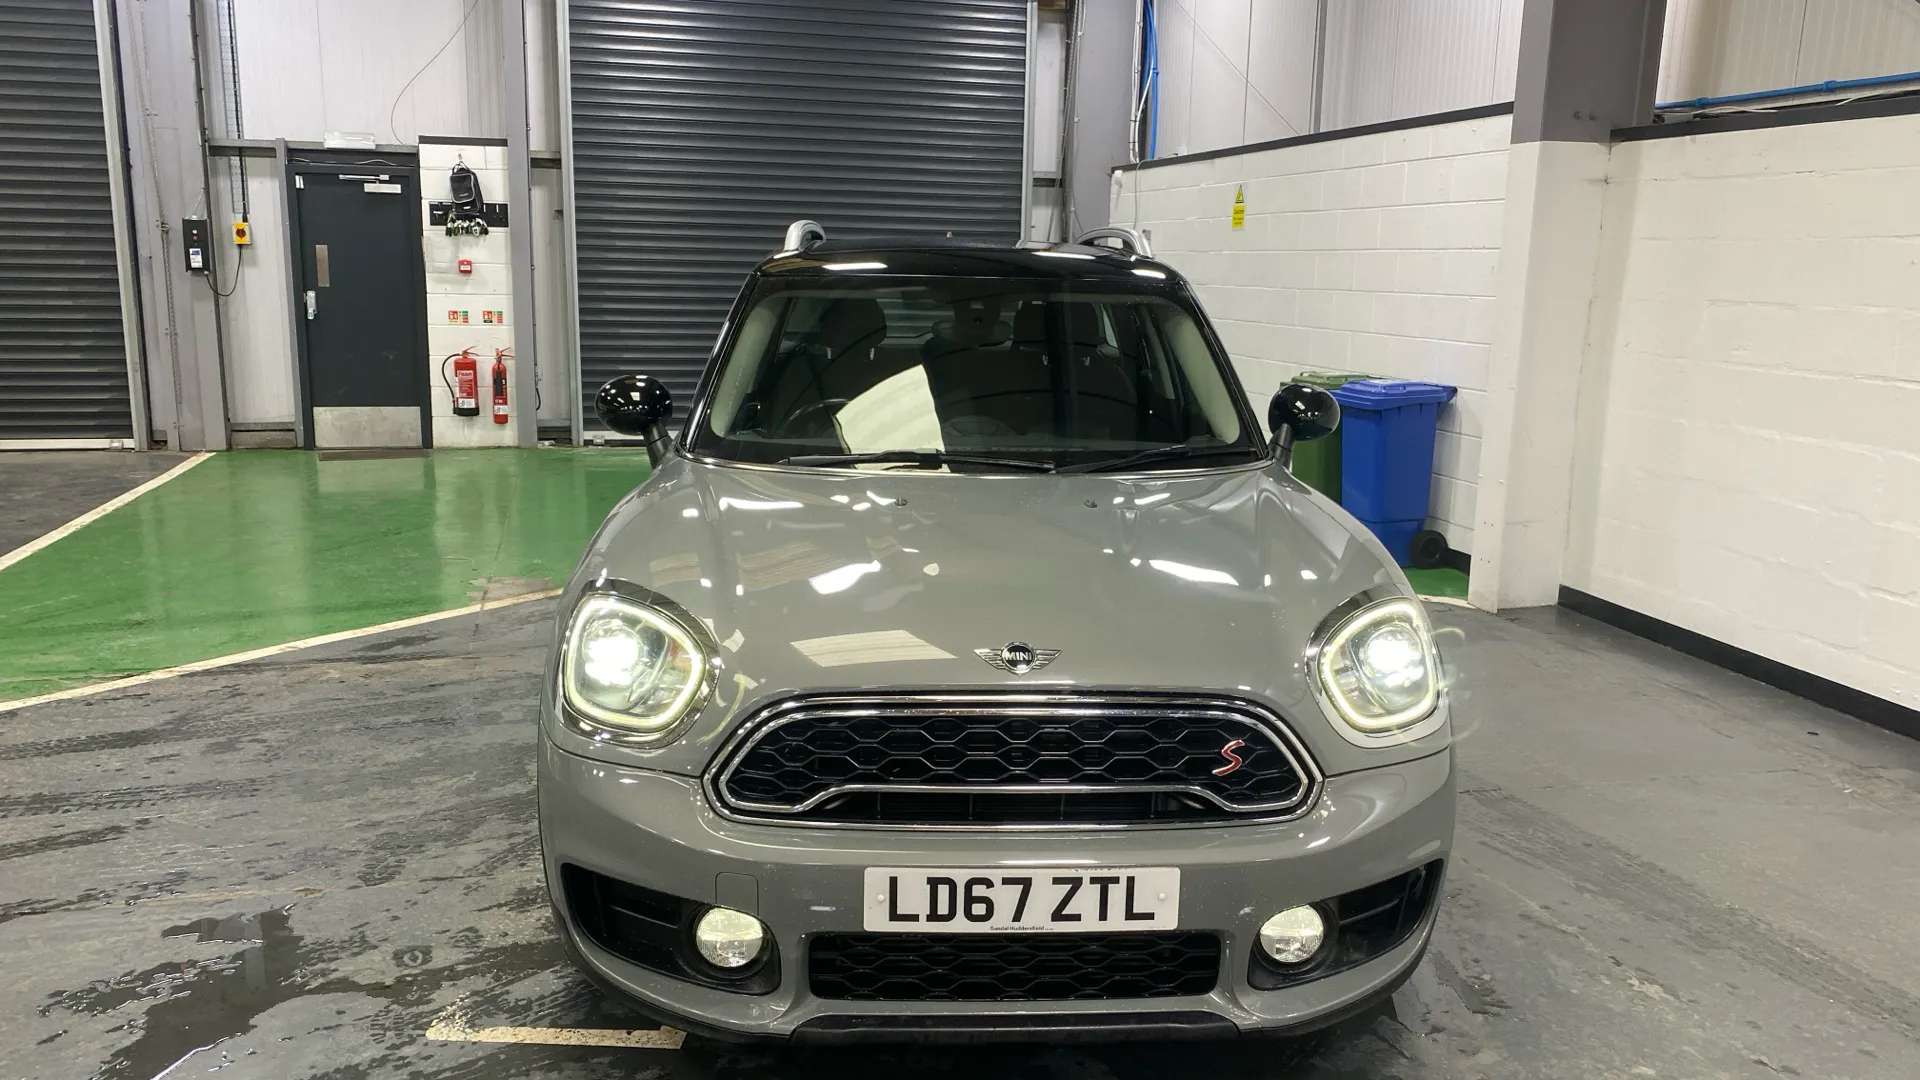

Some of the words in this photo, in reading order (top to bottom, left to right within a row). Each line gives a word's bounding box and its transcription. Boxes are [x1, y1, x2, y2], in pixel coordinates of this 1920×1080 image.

[1003, 651, 1033, 661] MINI
[1211, 739, 1246, 777] S
[888, 875, 1033, 923] LD67
[1050, 875, 1156, 922] ZTL
